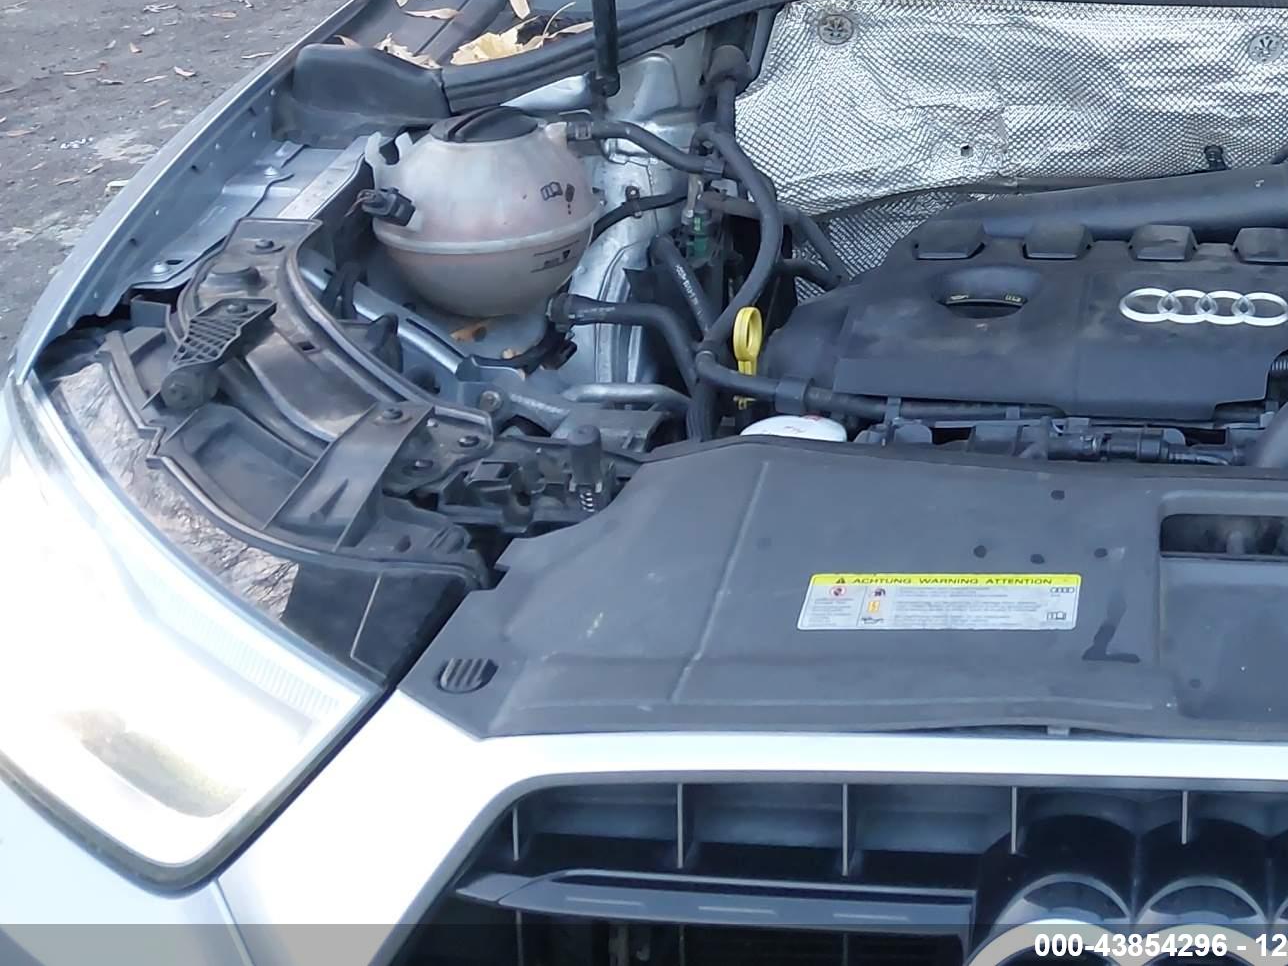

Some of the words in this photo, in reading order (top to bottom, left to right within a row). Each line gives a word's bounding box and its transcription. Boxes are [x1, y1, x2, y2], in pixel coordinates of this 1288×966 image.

[851, 577, 913, 585] ACHTUNG
[918, 577, 979, 585] WARNING
[985, 577, 1053, 585] ATTENTION
